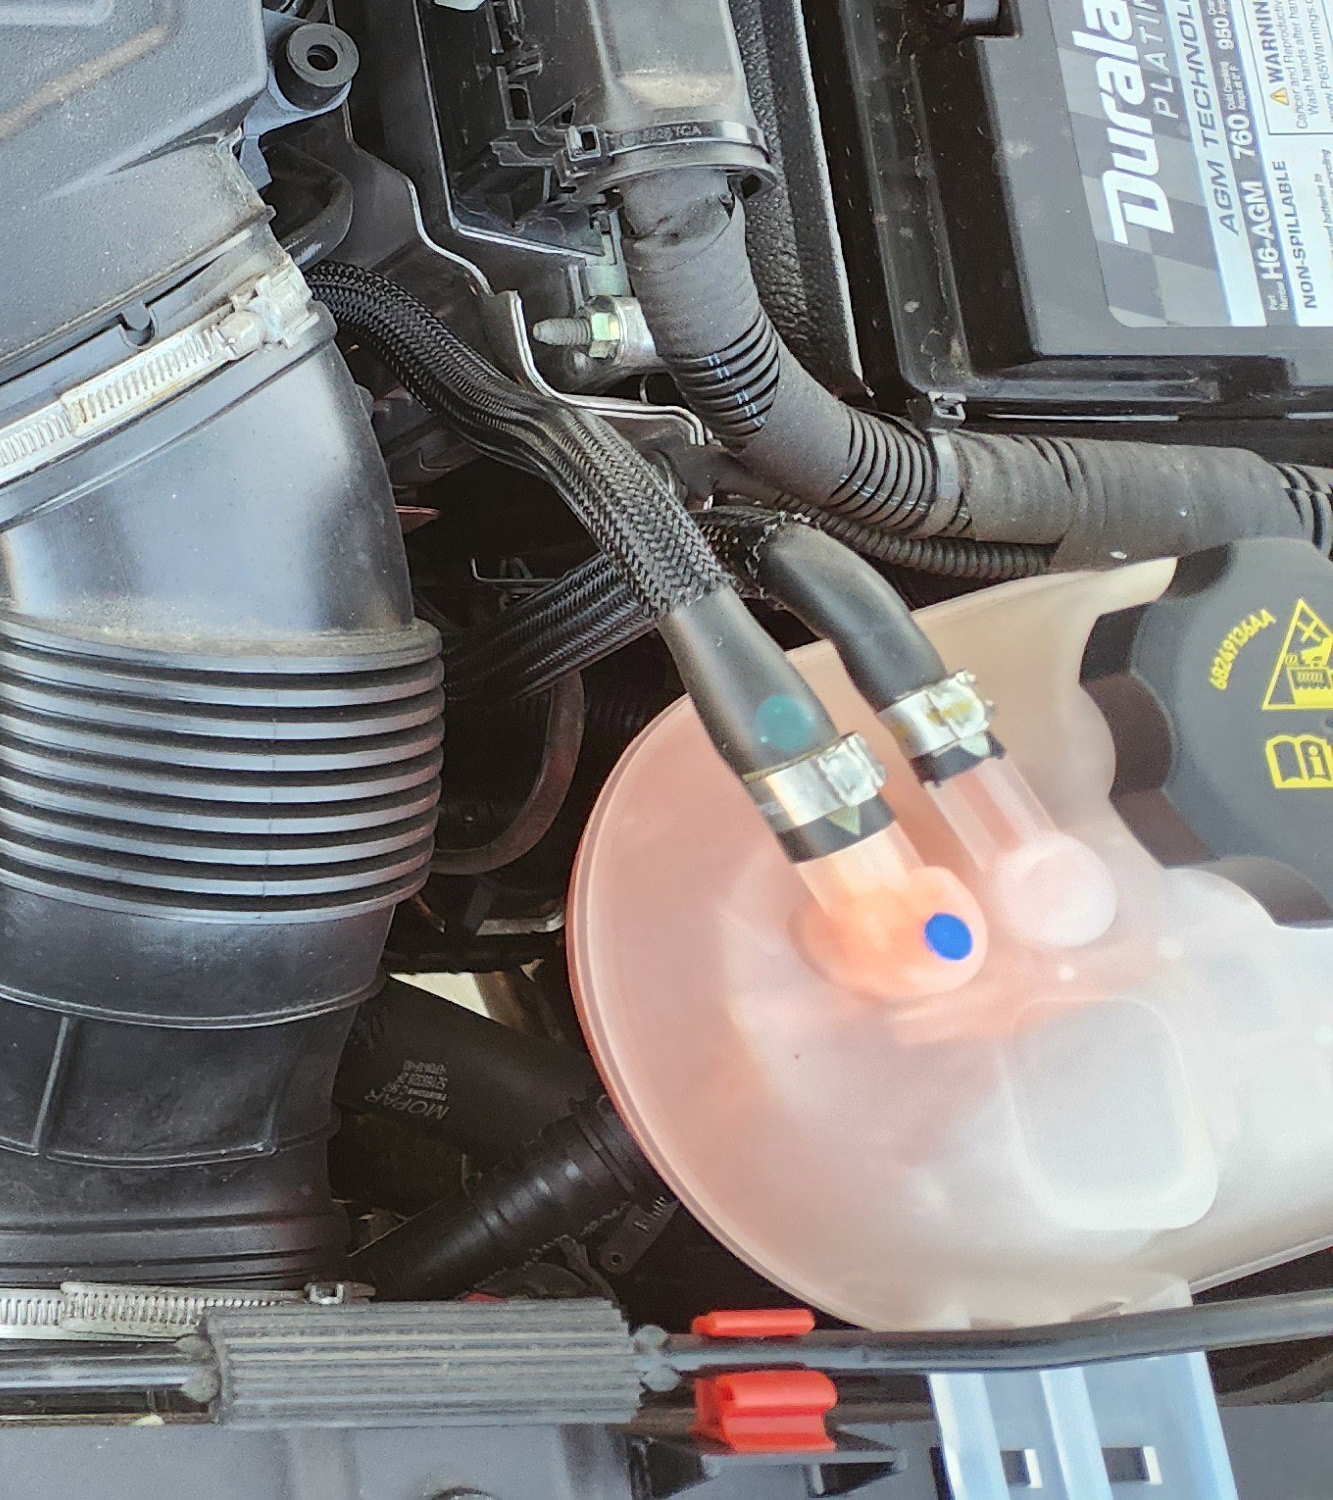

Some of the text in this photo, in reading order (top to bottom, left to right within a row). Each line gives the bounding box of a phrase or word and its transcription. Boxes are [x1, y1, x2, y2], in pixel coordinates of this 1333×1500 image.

[1211, 16, 1235, 51] 950
[1293, 21, 1307, 46] after
[1286, 66, 1301, 86] and
[1297, 51, 1312, 82] hands
[1290, 86, 1310, 130] Cancer
[1302, 82, 1320, 116] Wash
[1206, 159, 1240, 237] AGM
[1225, 113, 1285, 280] H6-AGM 760
[1271, 160, 1318, 310] NON-SPILLABLE
[364, 1088, 449, 1119] MOPAR
